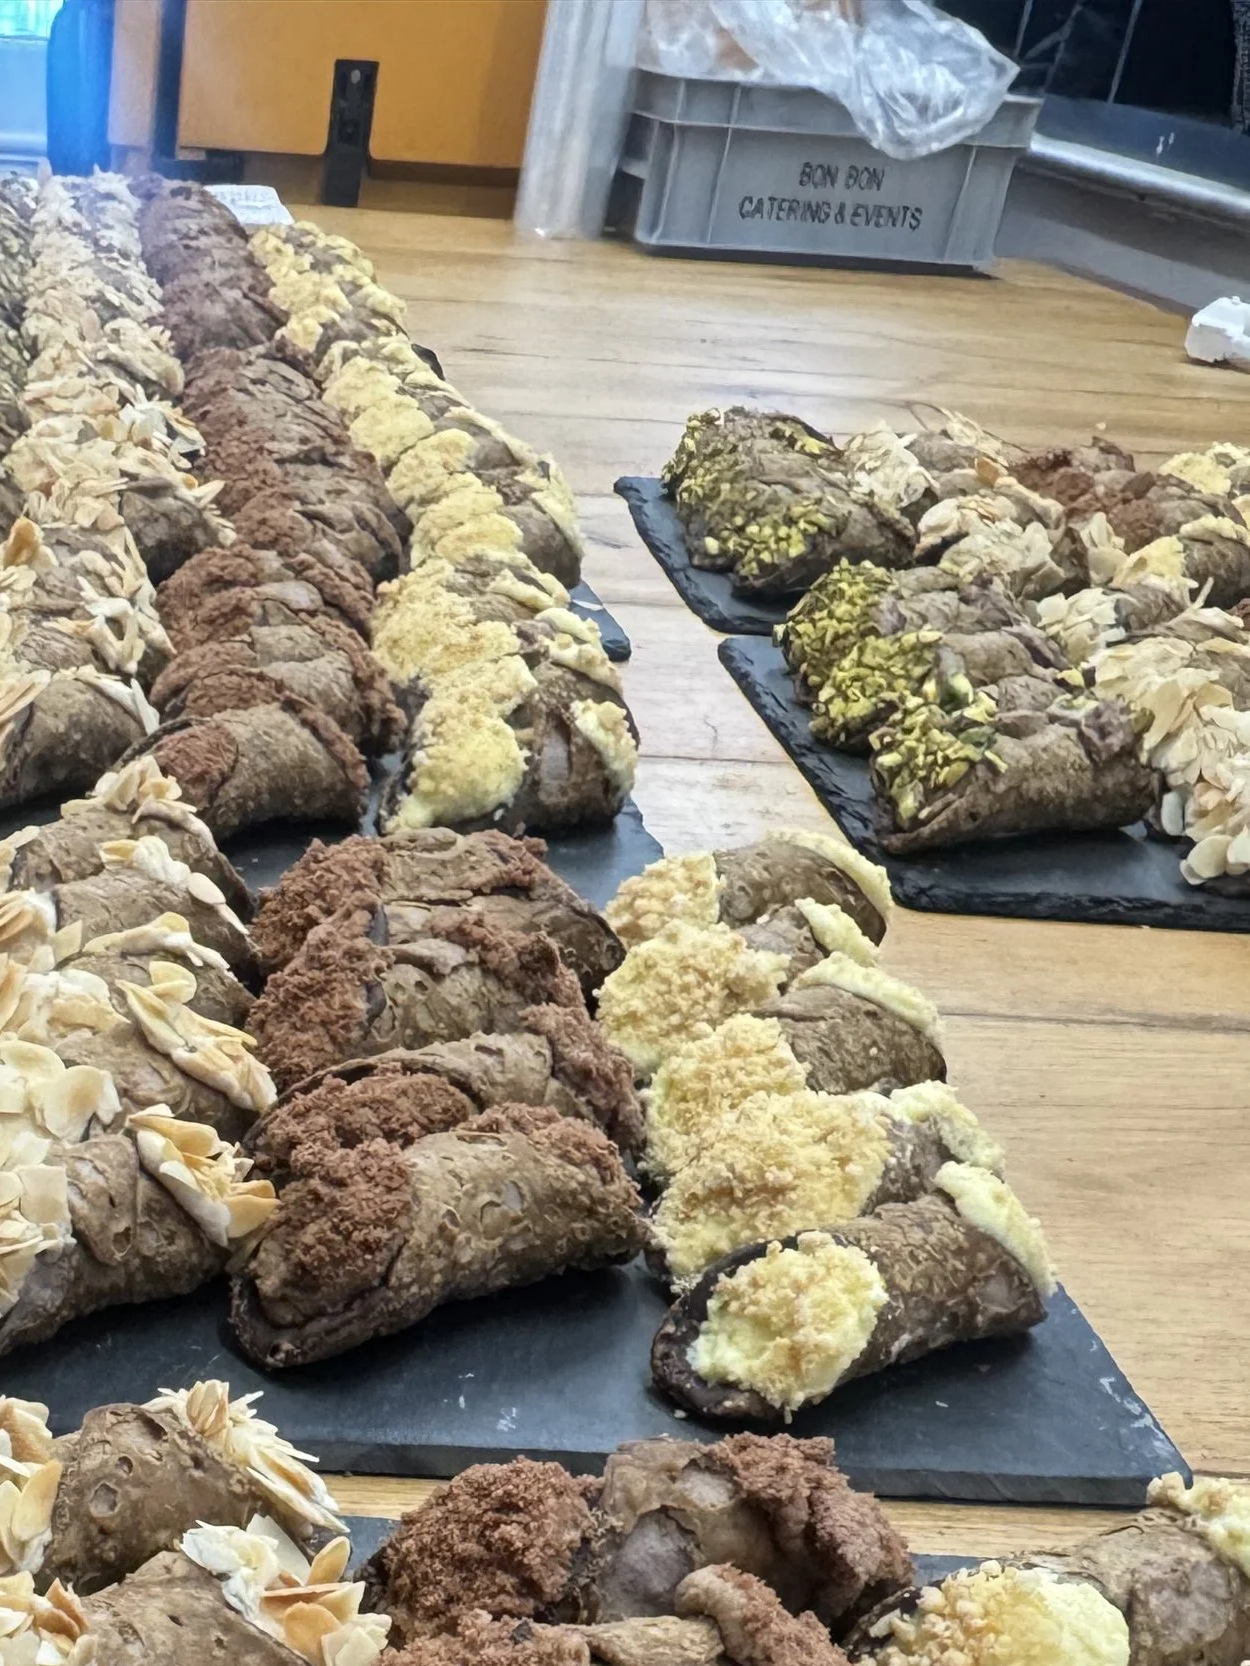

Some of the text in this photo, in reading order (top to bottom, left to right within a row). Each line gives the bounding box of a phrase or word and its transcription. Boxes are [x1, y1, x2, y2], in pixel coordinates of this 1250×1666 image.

[799, 161, 885, 191] BON BON
[738, 196, 923, 231] CATERING & EVENTS
